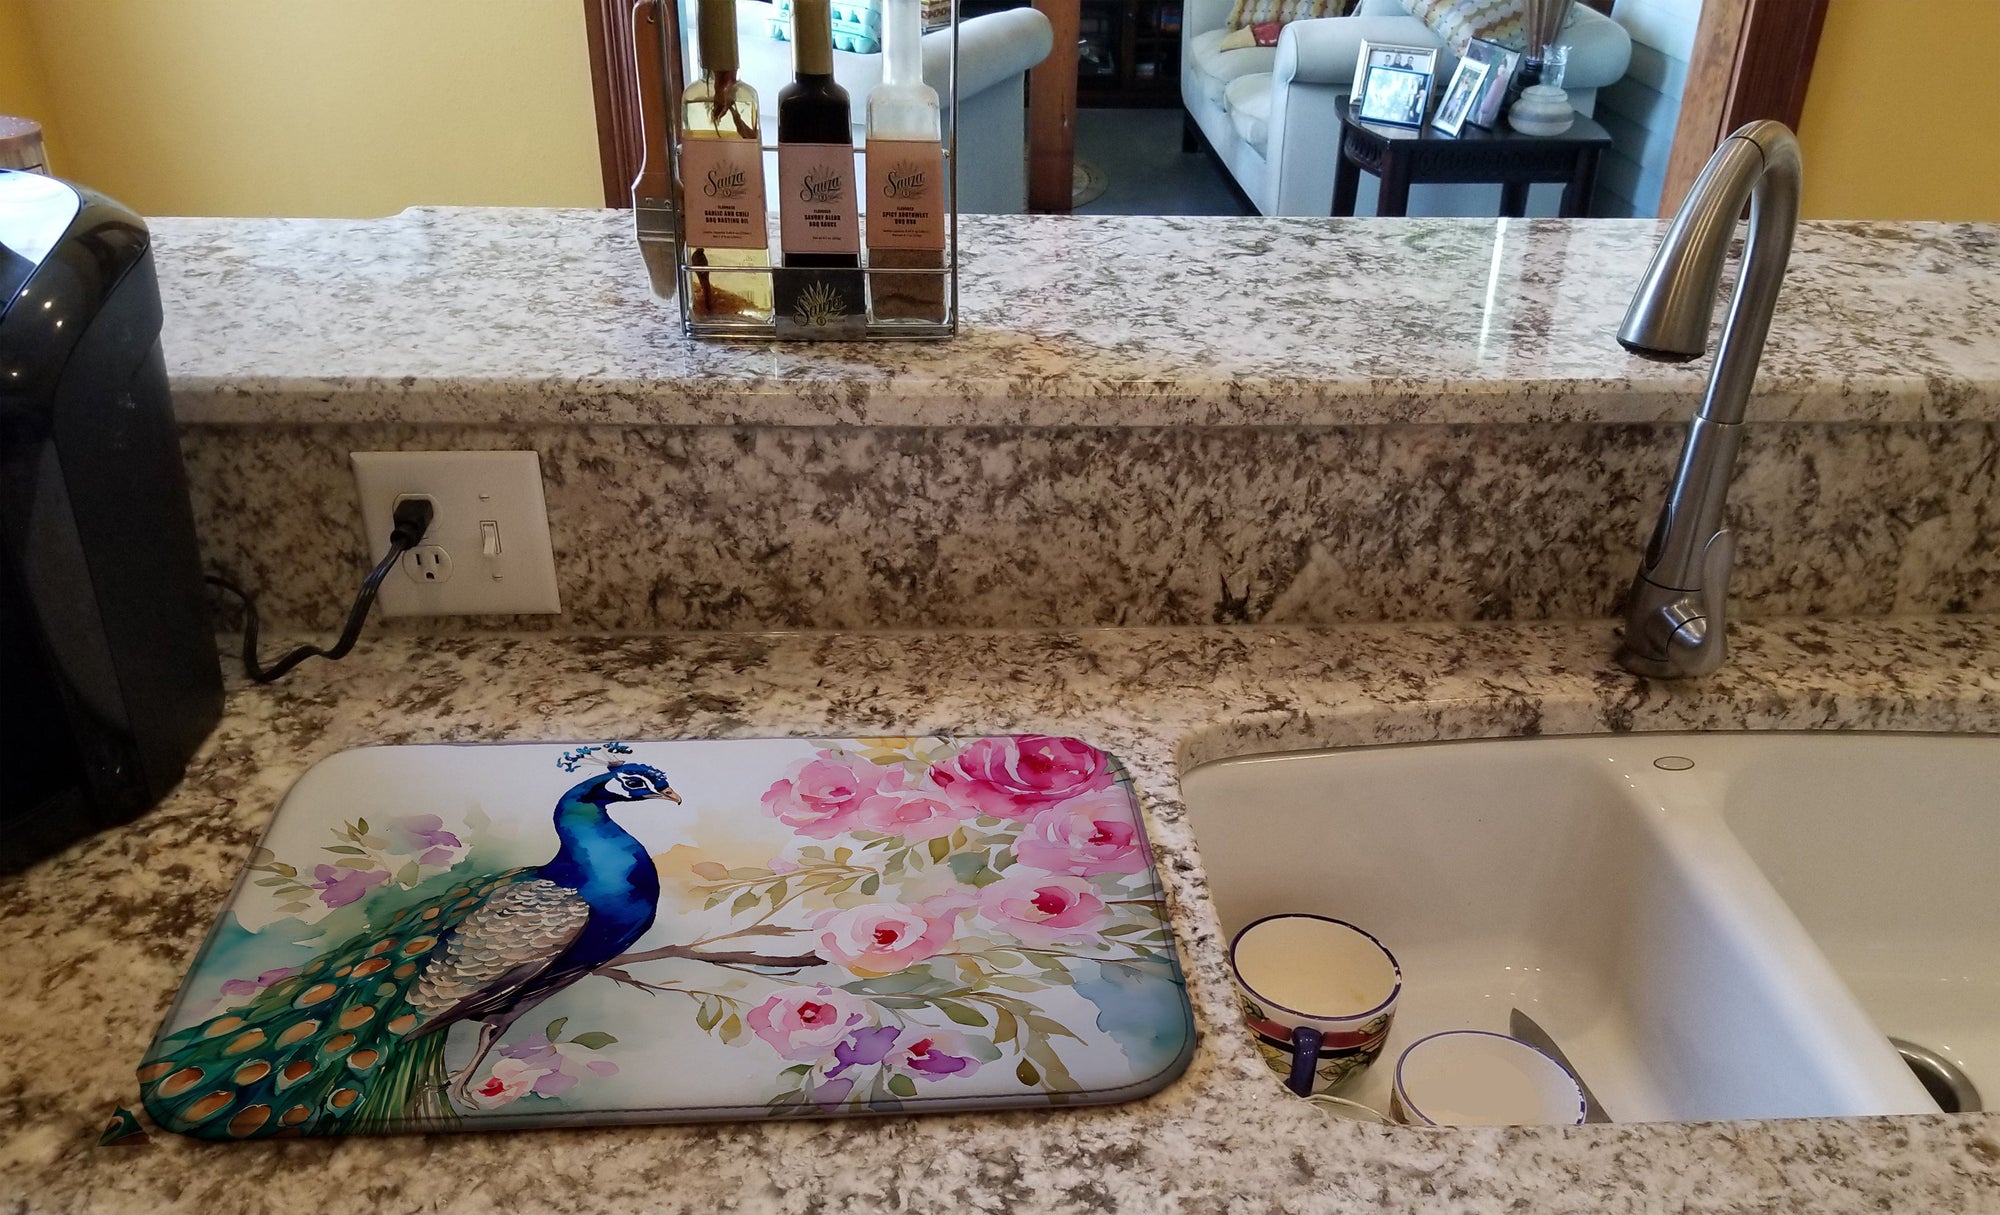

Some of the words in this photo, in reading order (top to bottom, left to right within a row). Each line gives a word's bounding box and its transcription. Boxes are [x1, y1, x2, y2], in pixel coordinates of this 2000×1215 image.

[703, 170, 746, 197] Sauza
[800, 175, 842, 202] Sauza
[883, 171, 925, 198] Sauza
